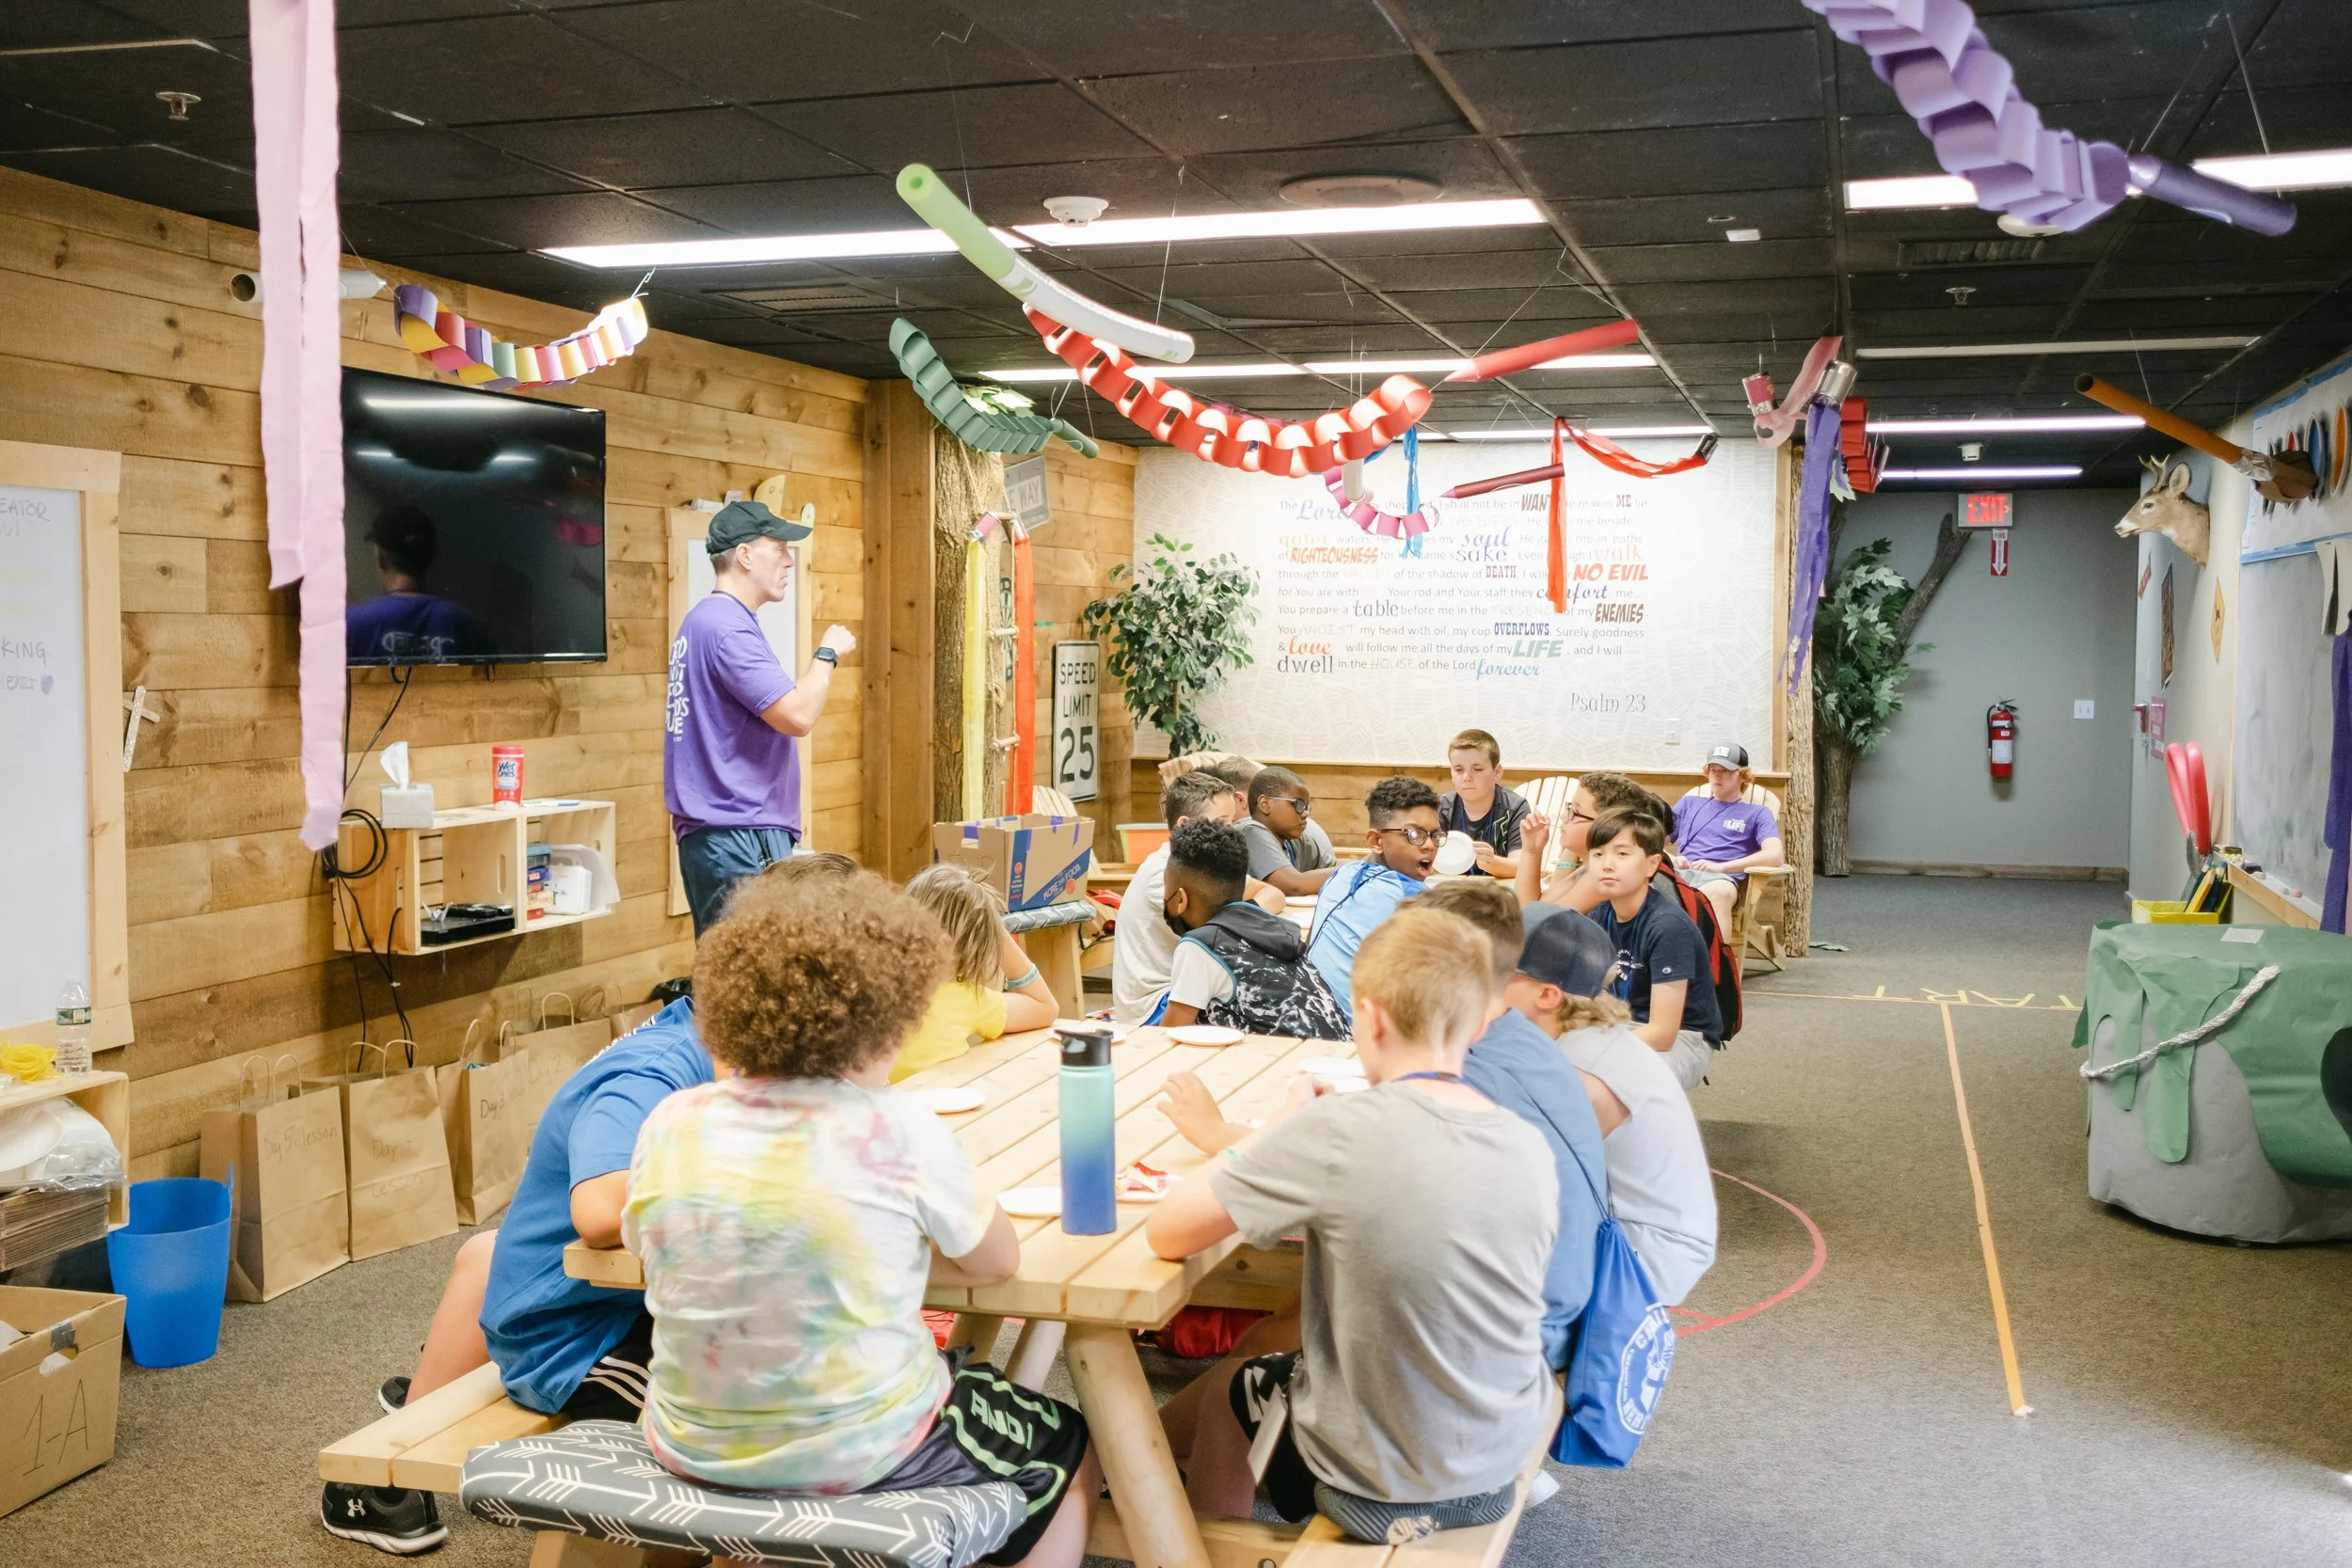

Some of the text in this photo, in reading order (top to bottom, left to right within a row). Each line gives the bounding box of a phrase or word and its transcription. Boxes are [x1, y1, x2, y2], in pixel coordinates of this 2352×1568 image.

[1019, 480, 1040, 510] WAY
[1279, 500, 1297, 511] The
[1445, 499, 1470, 510] shall
[1472, 500, 1489, 510] not
[1493, 499, 1506, 509] be
[1509, 500, 1519, 509] in
[1579, 499, 1612, 509] makes
[1616, 494, 1632, 508] ME
[1634, 499, 1647, 509] lie
[1527, 516, 1541, 526] He
[1597, 515, 1632, 526] beside
[1968, 496, 2007, 524] EXIT
[1439, 537, 1454, 546] my
[1460, 525, 1510, 548] soul
[1520, 533, 1534, 544] He
[1576, 535, 1593, 544] me
[1597, 534, 1608, 543] in
[1613, 533, 1643, 546] paths
[1279, 549, 1289, 561] of
[1290, 546, 1378, 564] RIGHTEOUSNESS
[1380, 550, 1395, 560] for
[1455, 546, 1507, 563] sake
[1518, 550, 1543, 561] Even
[1594, 544, 1644, 562] walk
[1279, 568, 1319, 580] through
[1322, 568, 1339, 578] the
[1393, 568, 1406, 578] of
[1408, 568, 1424, 578] the
[1427, 567, 1469, 578] shadow
[1472, 568, 1484, 579] of
[1573, 562, 1603, 581] NO
[1607, 563, 1649, 581] EVIL
[1278, 586, 1292, 596] for
[1295, 587, 1313, 596] You
[1336, 587, 1359, 596] with
[1388, 587, 1411, 597] Your
[1414, 586, 1432, 597] rod
[1435, 586, 1454, 597] and
[1457, 587, 1480, 598] Your
[1484, 586, 1507, 597] staff
[1510, 586, 1534, 600] they
[1279, 605, 1296, 615] You
[1299, 606, 1340, 618] prepare
[1353, 598, 1399, 618] table
[1401, 604, 1435, 615] before
[1438, 607, 1454, 615] me
[1457, 605, 1467, 615] in
[1470, 605, 1487, 616] the
[1578, 607, 1594, 618] my
[1595, 603, 1645, 625] ENEMIES
[1278, 625, 1296, 635] You
[1297, 624, 1355, 637] ANOINT
[1359, 626, 1375, 637] my
[1378, 625, 1405, 636] head
[1407, 625, 1431, 636] with
[1453, 627, 1468, 639] my
[1471, 627, 1491, 639] cup
[1556, 626, 1589, 639] Surely
[1592, 627, 1645, 640] goodness
[1278, 642, 1286, 652] &
[1288, 635, 1332, 656] love
[1345, 642, 1363, 653] will
[1366, 642, 1398, 654] follow
[1421, 642, 1433, 654] all
[1437, 642, 1454, 654] the
[1456, 644, 1480, 657] days
[1483, 644, 1494, 654] of
[1497, 646, 1513, 657] my
[1512, 640, 1564, 659] LIFE
[1573, 644, 1594, 656] and
[1604, 645, 1623, 656] will
[1059, 662, 1096, 686] SPEED
[1278, 655, 1334, 674] dwell
[1338, 659, 1347, 670] in
[1350, 659, 1367, 670] the
[1369, 657, 1415, 671] HOUSE
[1419, 659, 1430, 670] of
[1433, 659, 1449, 671] the
[1453, 659, 1476, 671] Lord
[1062, 694, 1092, 719] LIMIT
[1570, 692, 1646, 713] Psalm 23
[1059, 725, 1095, 784] 25
[373, 1138, 397, 1165] Day
[371, 1173, 425, 1199] Lesson
